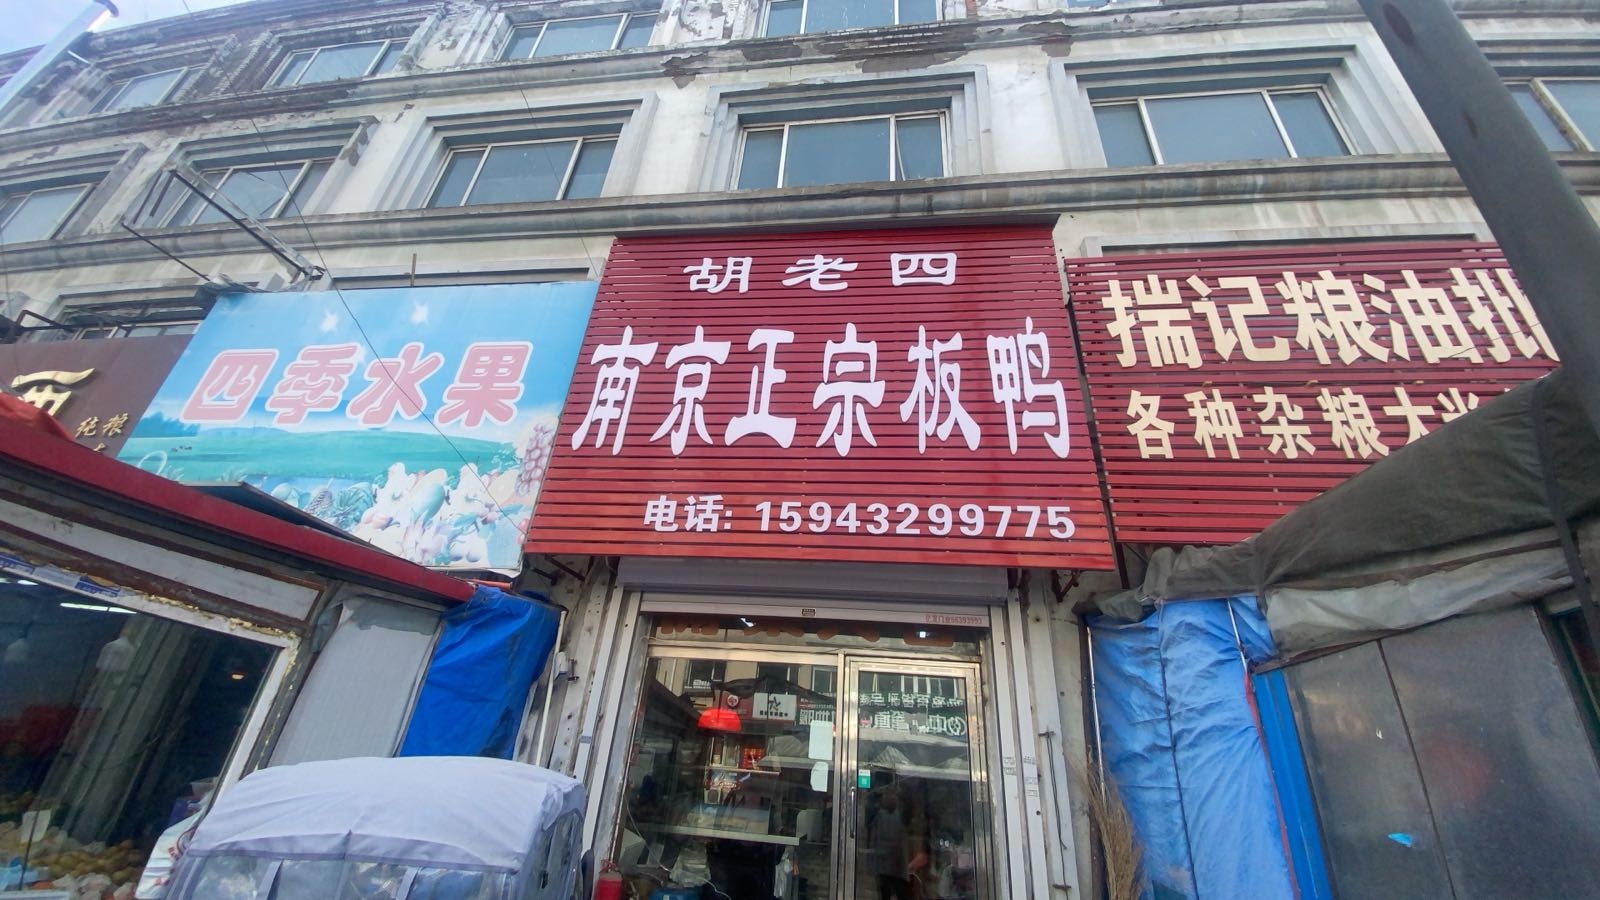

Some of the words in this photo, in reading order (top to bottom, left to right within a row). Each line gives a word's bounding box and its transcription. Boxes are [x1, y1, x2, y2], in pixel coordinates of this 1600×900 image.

[683, 252, 957, 293] 胡老四
[180, 341, 534, 429] 四季水果
[571, 316, 1070, 459] 南京正宗板鸭
[755, 501, 1076, 540] 15943299775
